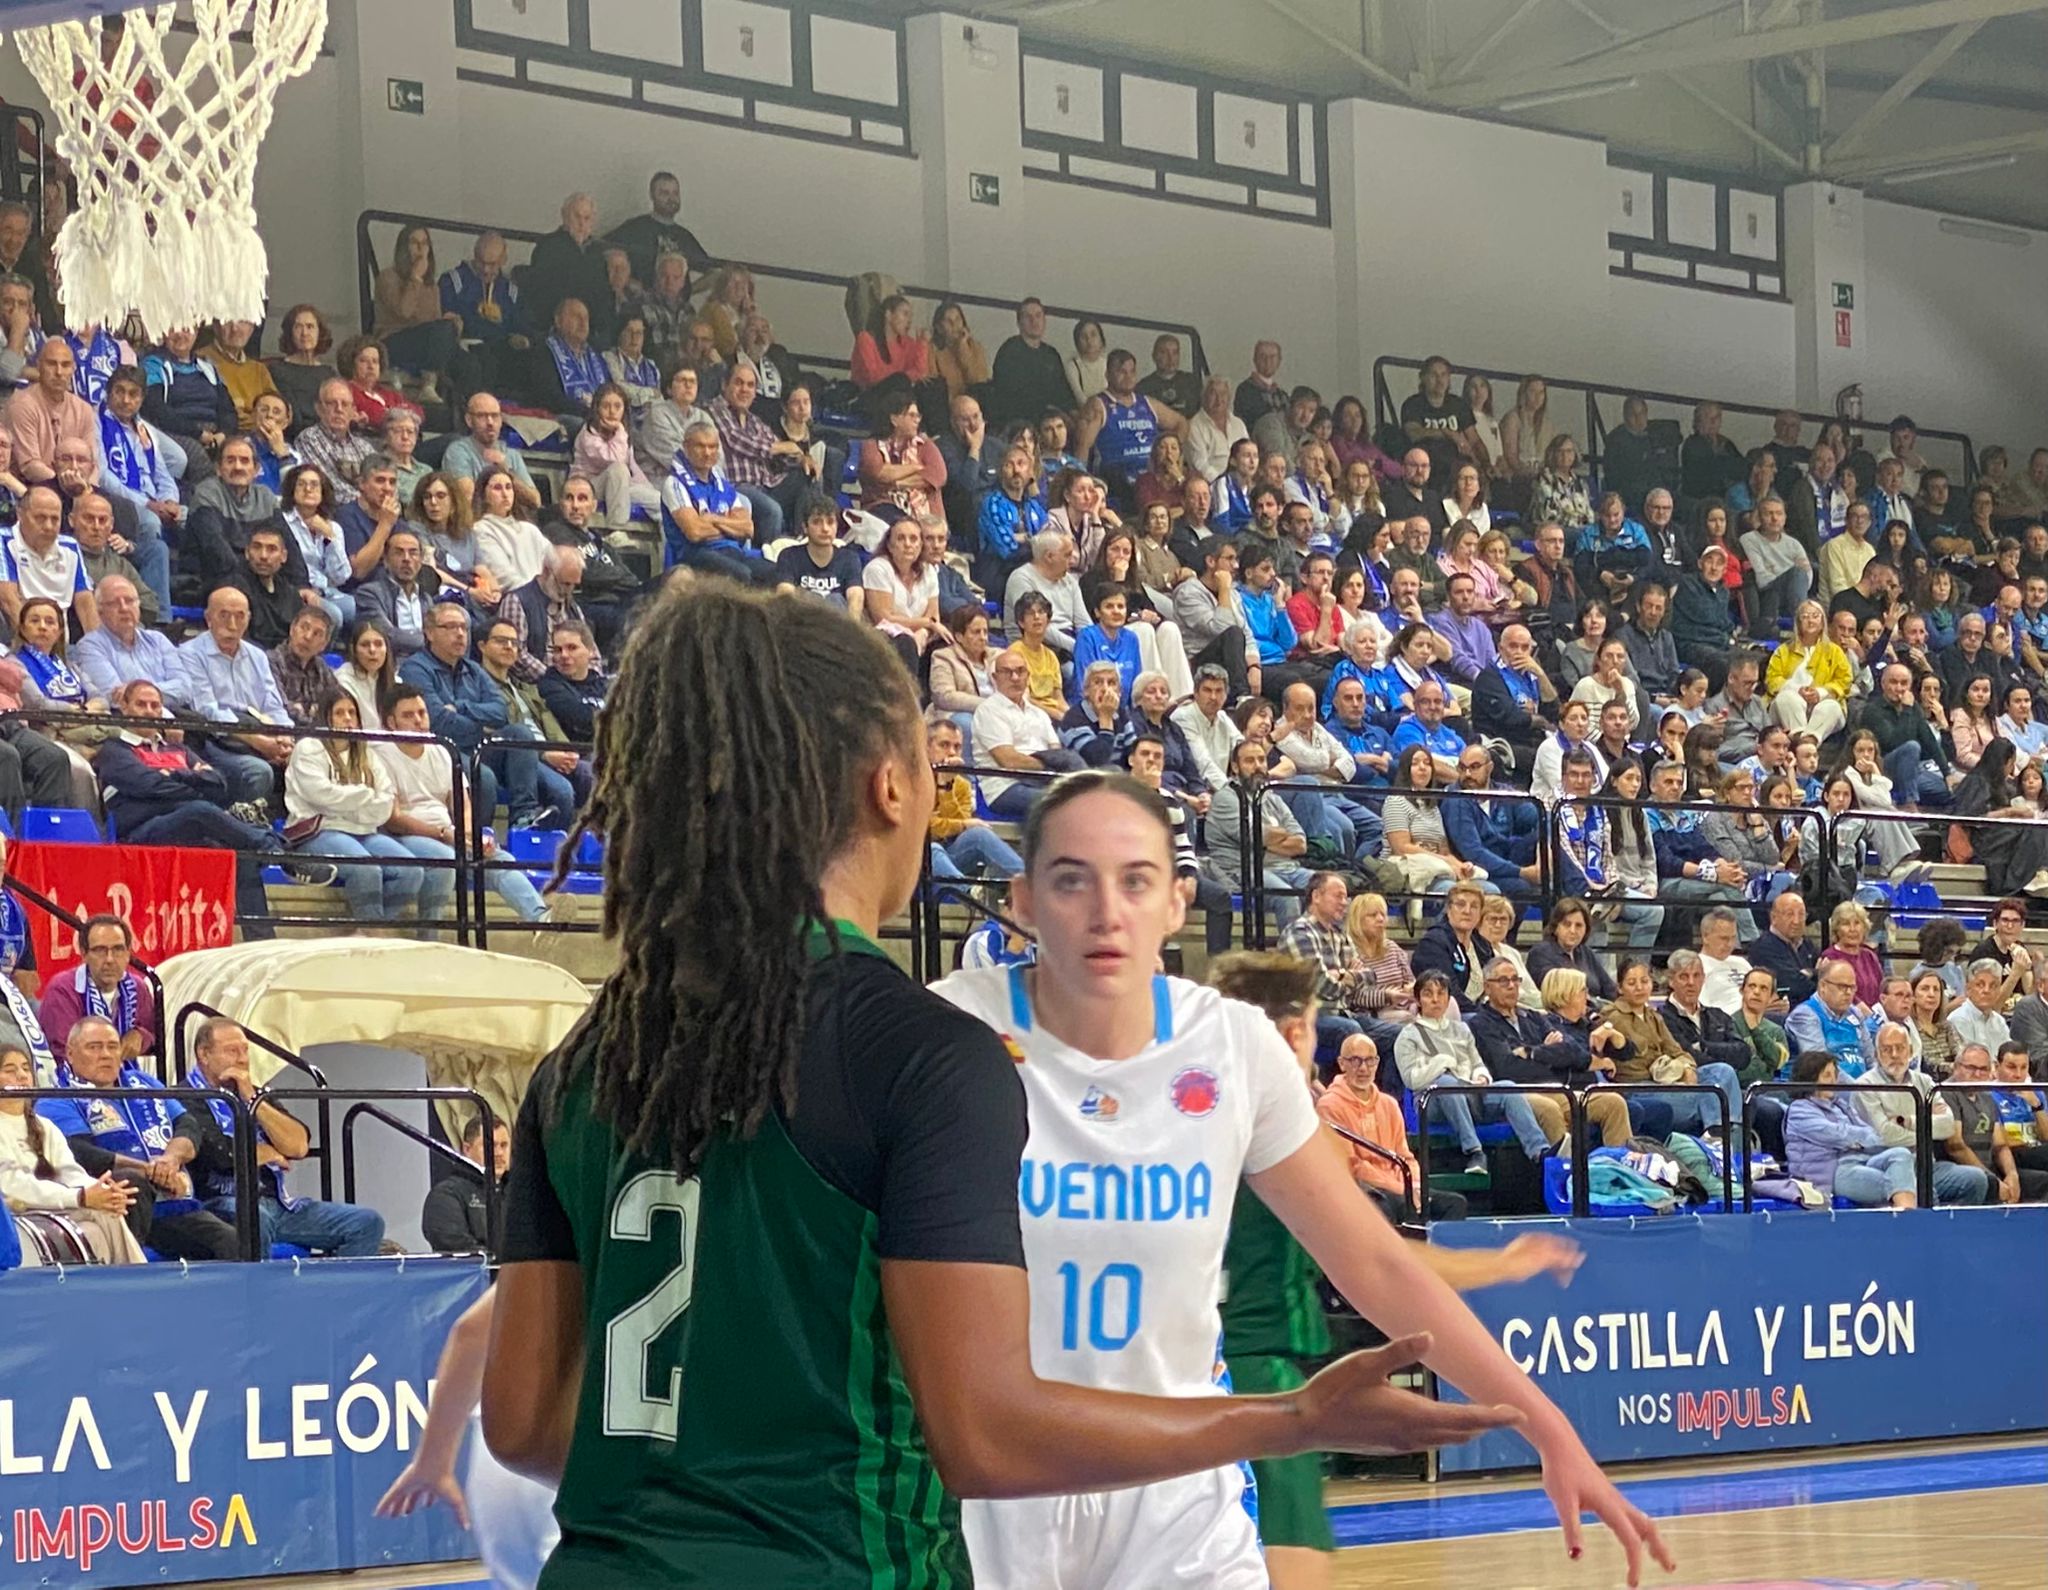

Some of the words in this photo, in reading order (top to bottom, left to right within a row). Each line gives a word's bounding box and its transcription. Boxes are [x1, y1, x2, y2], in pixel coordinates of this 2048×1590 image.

[800, 575, 840, 590] SEOUL
[603, 1169, 701, 1442] 2
[1056, 1260, 1143, 1351] 10
[1502, 1309, 1729, 1376] CASTILLA
[1754, 1305, 1785, 1376] Y
[1803, 1280, 1916, 1360] LEÓN
[153, 1389, 209, 1483] Y
[1618, 1393, 1672, 1426] NOS
[1676, 1384, 1812, 1440] IMPULSA
[14, 1493, 258, 1571] IMPULSA
